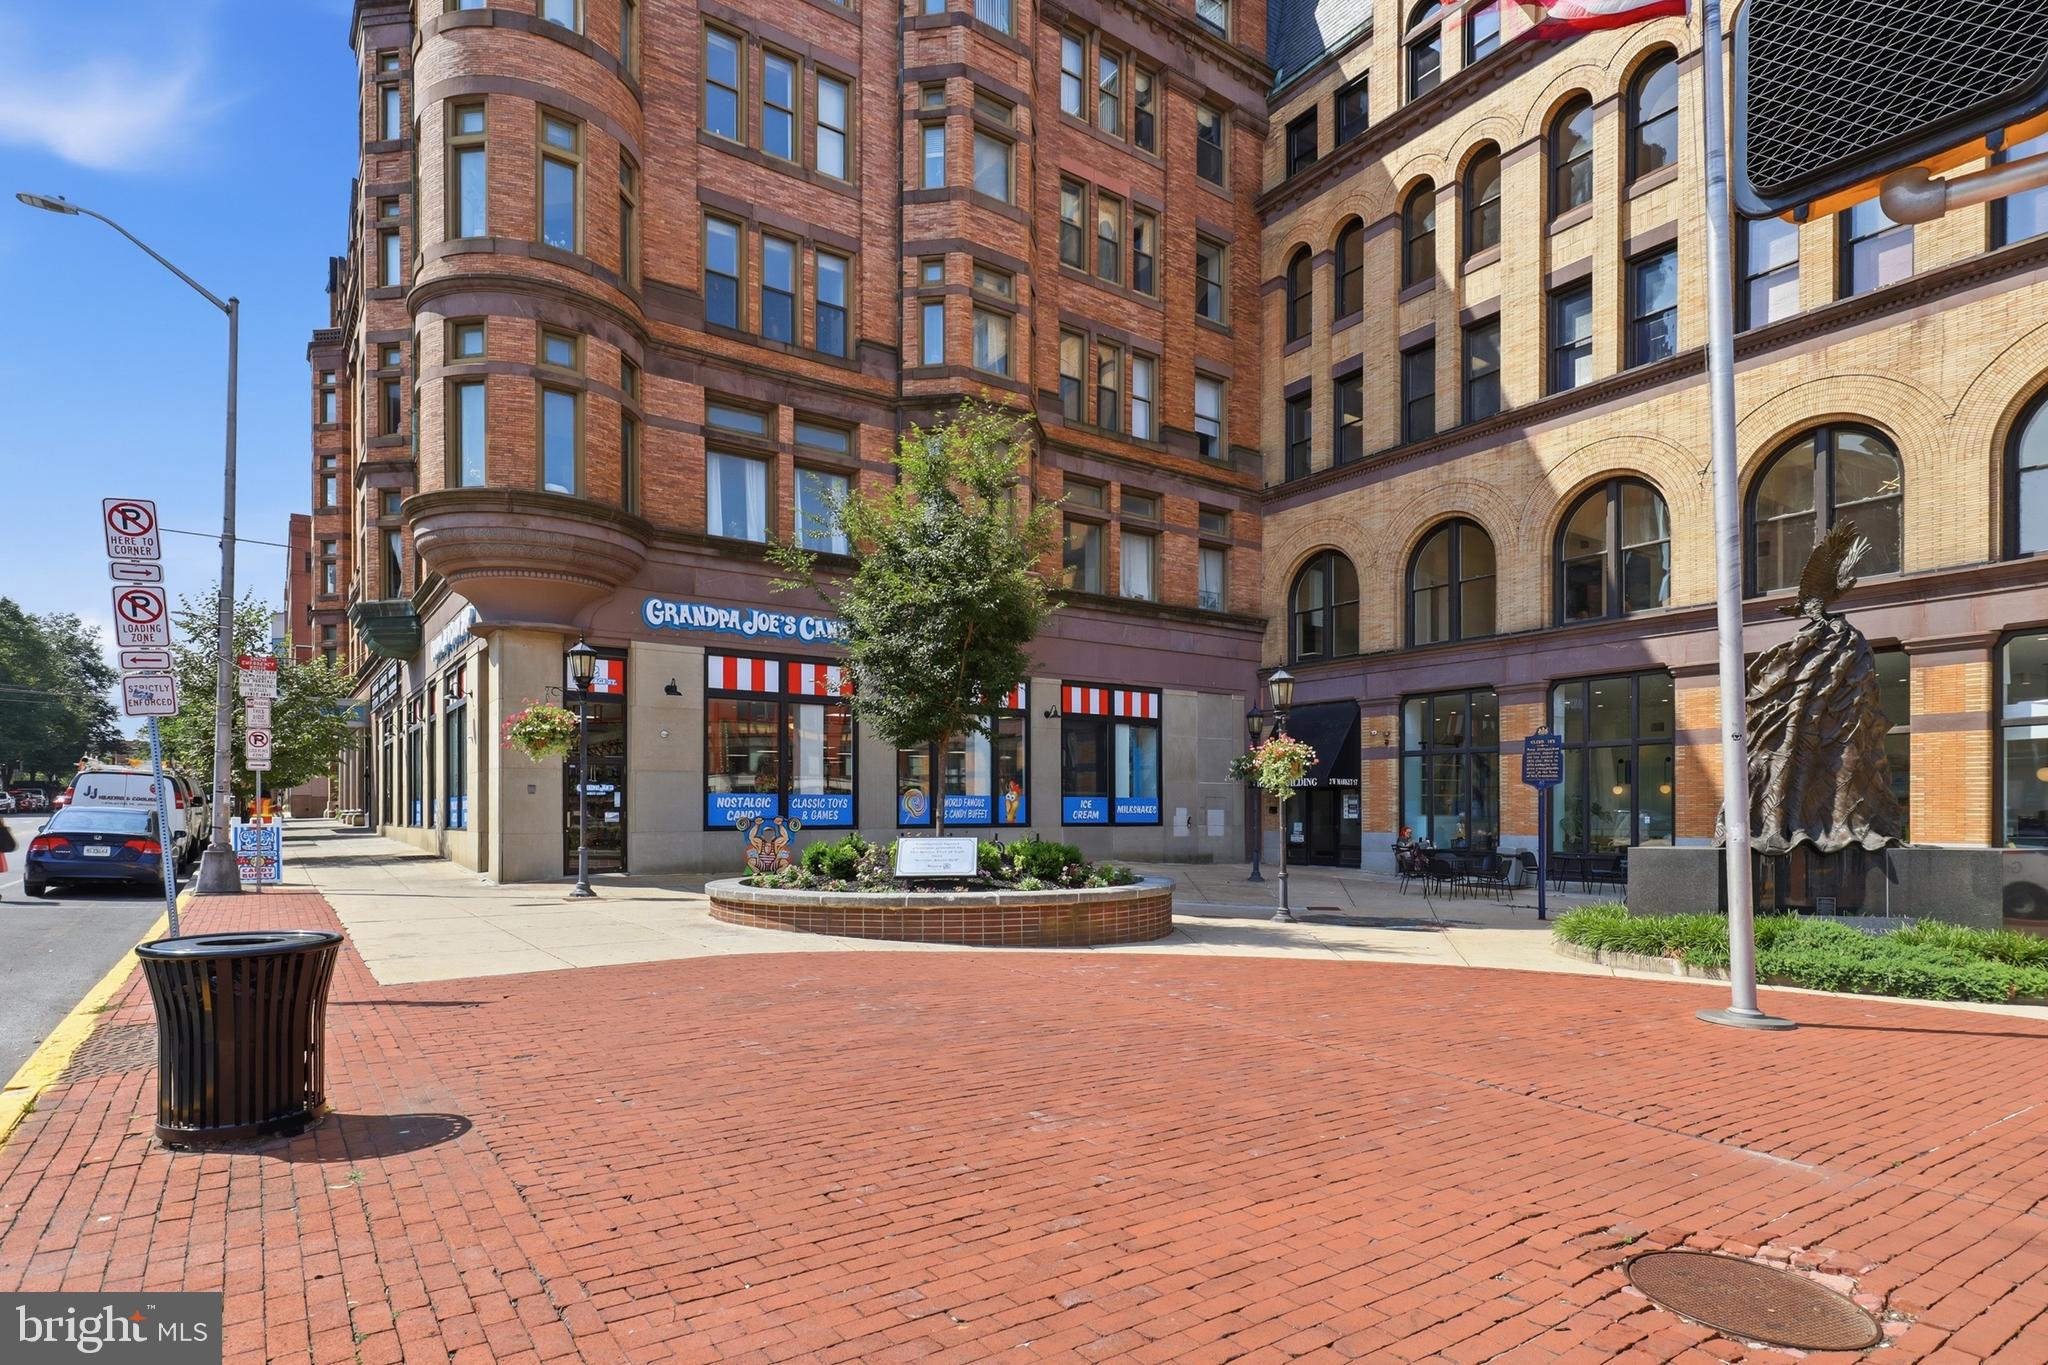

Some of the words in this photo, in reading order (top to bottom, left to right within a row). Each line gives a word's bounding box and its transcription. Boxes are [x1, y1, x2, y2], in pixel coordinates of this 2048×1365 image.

[111, 536, 137, 546] HERE
[143, 538, 154, 546] TO
[114, 545, 152, 556] CORNER
[646, 598, 740, 630] GRANDPA
[742, 610, 797, 634] JOE'S
[123, 624, 162, 633] LOADING
[131, 633, 155, 643] ZONE
[128, 684, 169, 692] STRICTLY
[128, 698, 173, 707] ENFORCED
[716, 797, 772, 808] NOSTALGIC
[792, 798, 826, 809] CLASSIC
[828, 799, 848, 809] TOYS
[1080, 800, 1092, 808] ICE
[1116, 805, 1156, 814] MILKSHAKES
[726, 810, 762, 821] CANDY
[802, 811, 808, 820] &
[810, 810, 839, 820] GAMES
[1072, 810, 1100, 820] CREAM
